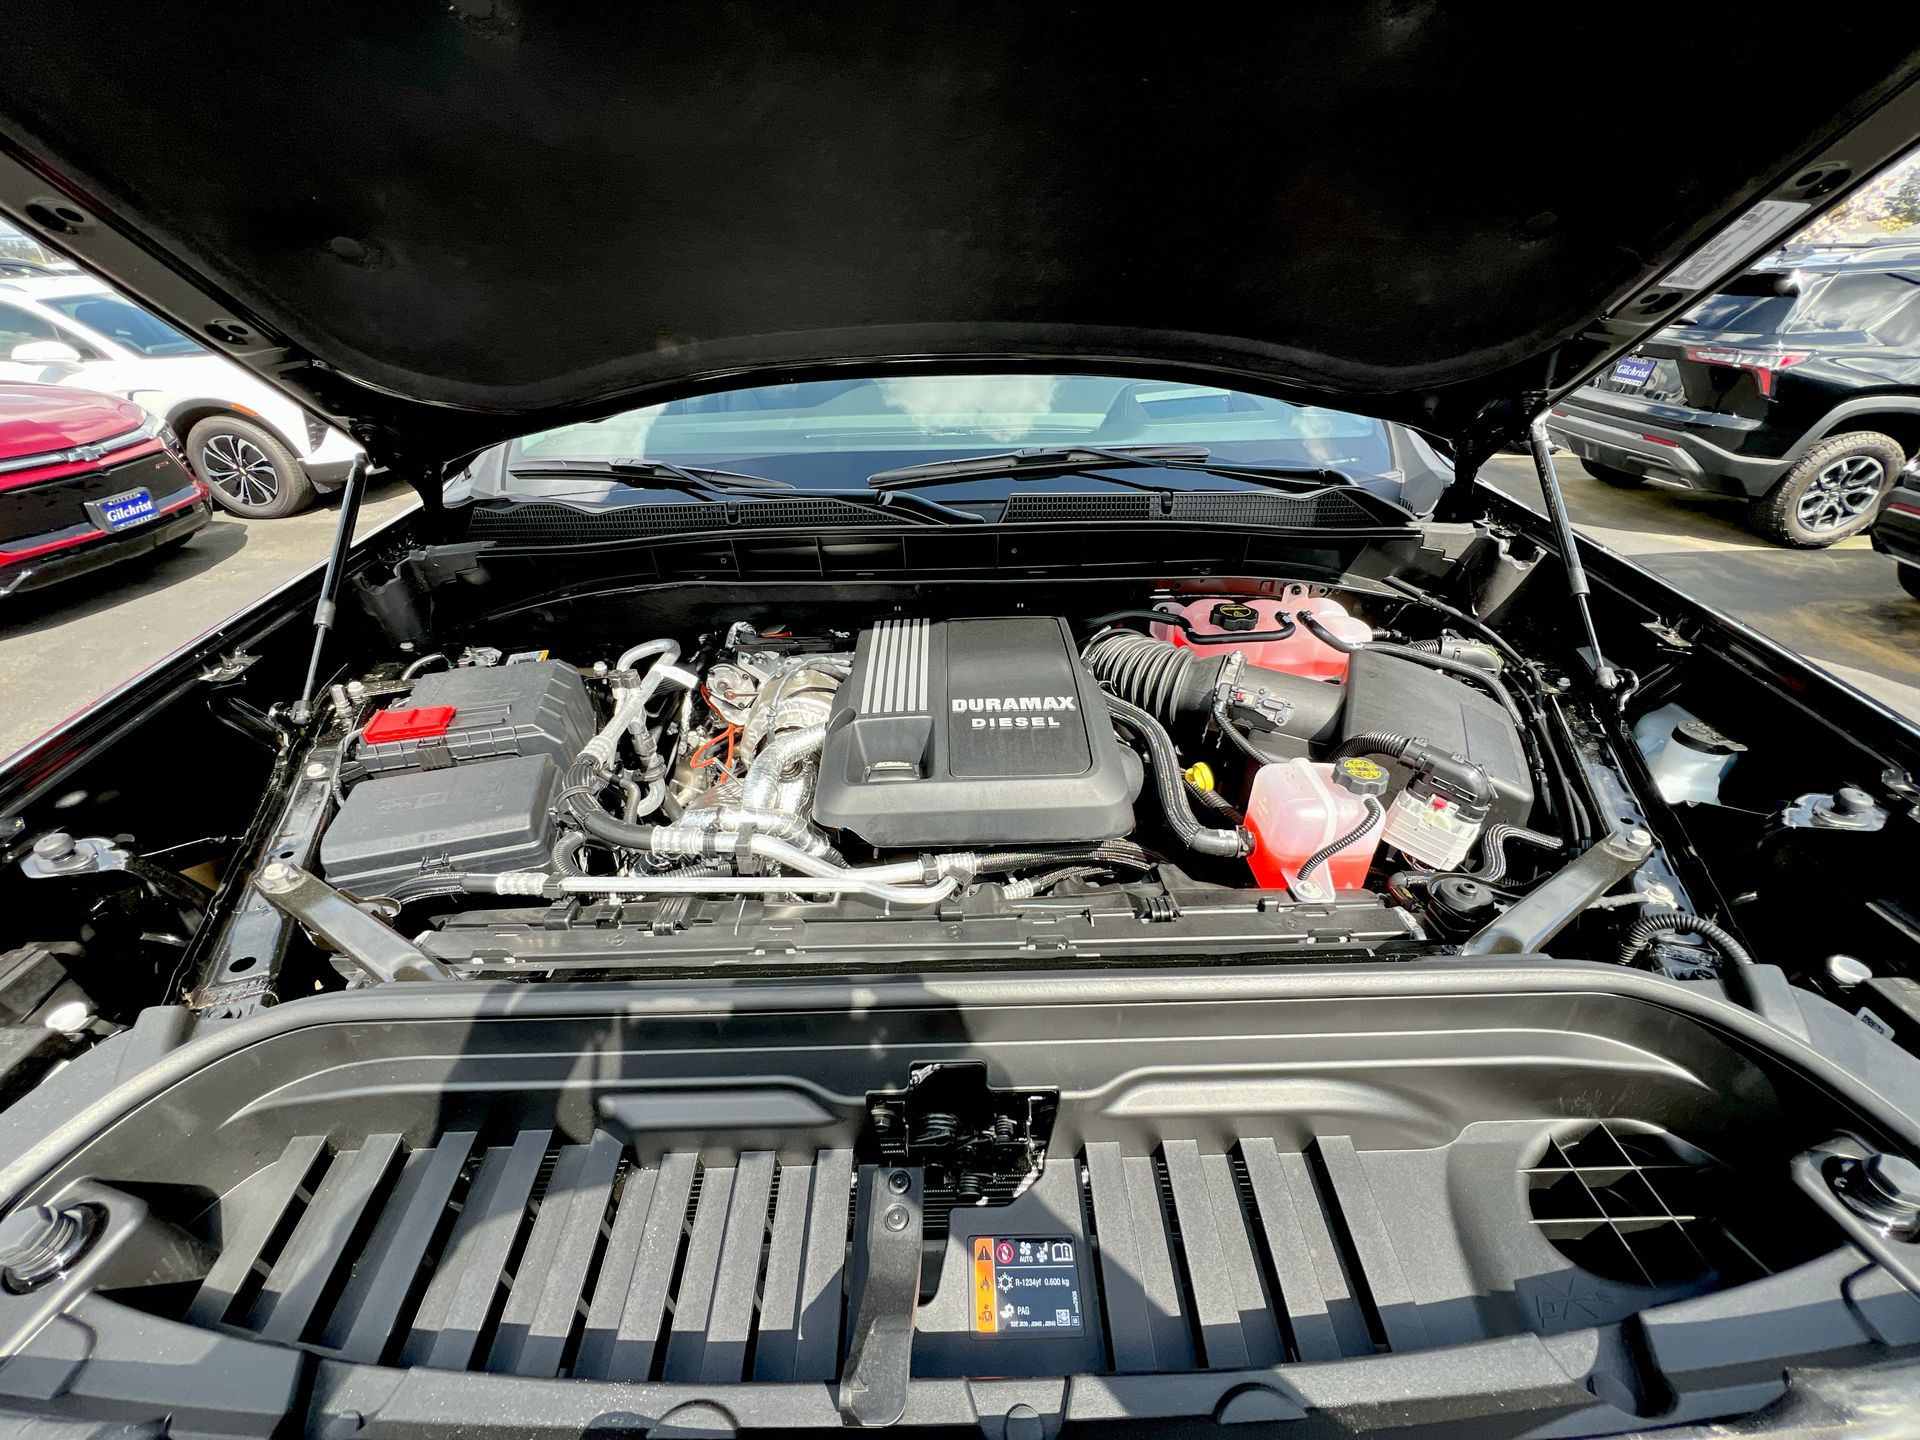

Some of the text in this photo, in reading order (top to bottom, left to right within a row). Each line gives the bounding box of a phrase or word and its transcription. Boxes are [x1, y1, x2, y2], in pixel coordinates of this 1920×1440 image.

[1616, 364, 1650, 378] Gilchrist
[106, 500, 153, 522] Gilchrist
[951, 696, 1077, 713] DURAMAX
[971, 716, 1061, 730] DIESEL
[1019, 1255, 1034, 1263] AUTO
[1015, 1277, 1042, 1288] R-1234yf
[1061, 1277, 1070, 1288] kg
[1017, 1306, 1030, 1316] PAG
